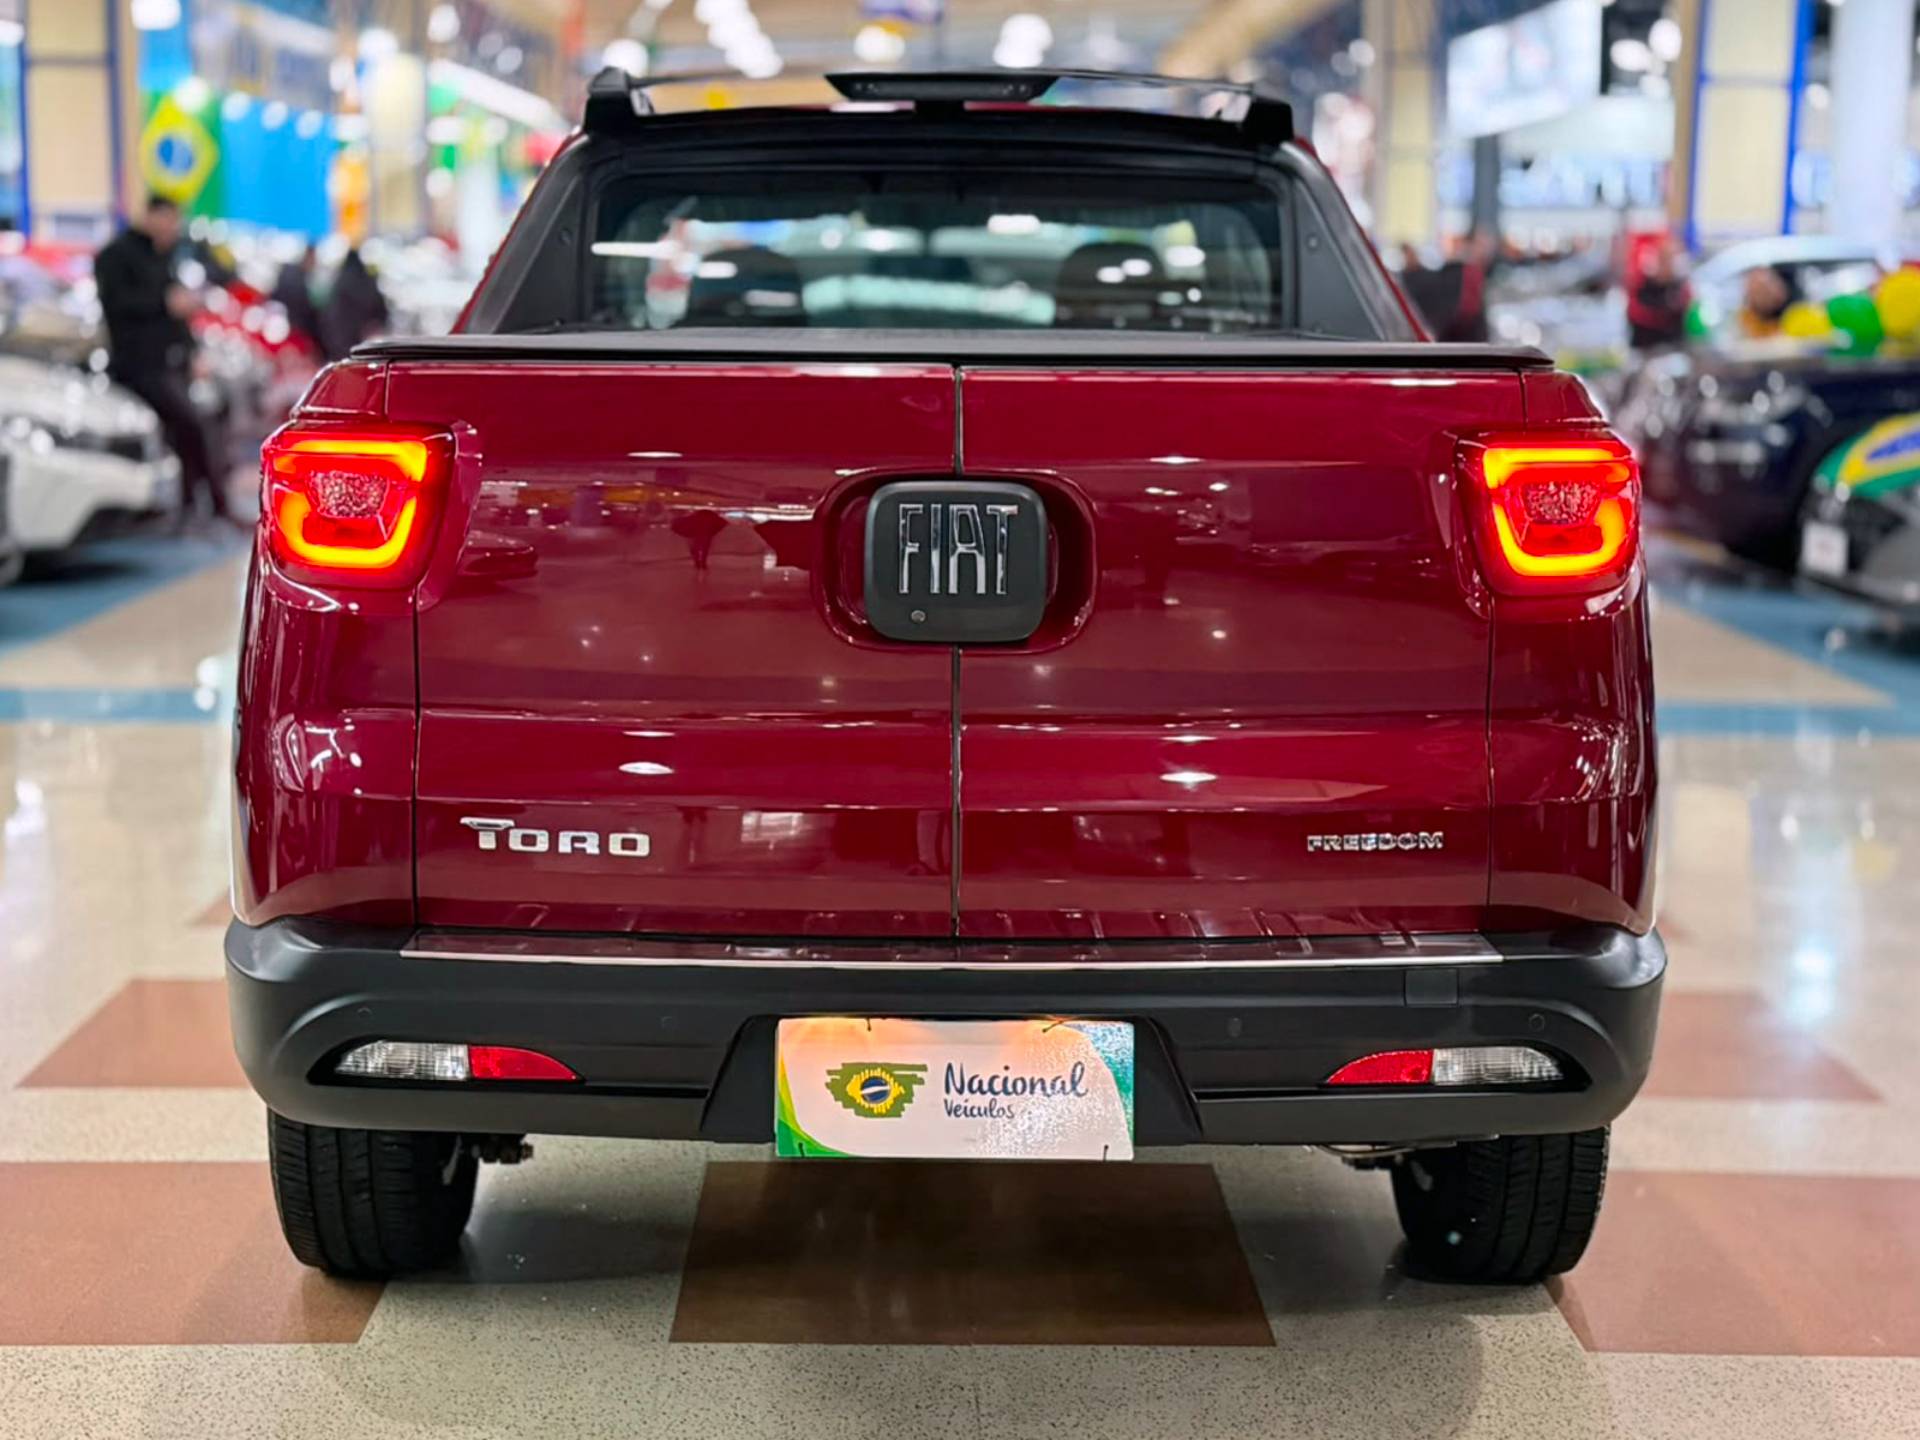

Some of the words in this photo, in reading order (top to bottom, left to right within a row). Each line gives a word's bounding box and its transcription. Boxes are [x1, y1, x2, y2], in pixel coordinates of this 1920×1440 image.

[899, 503, 1019, 595] FIAT
[460, 816, 650, 857] TORO
[1306, 831, 1444, 851] FREEDOM
[944, 1061, 1089, 1098] Nacional
[943, 1098, 1015, 1119] Veículos
